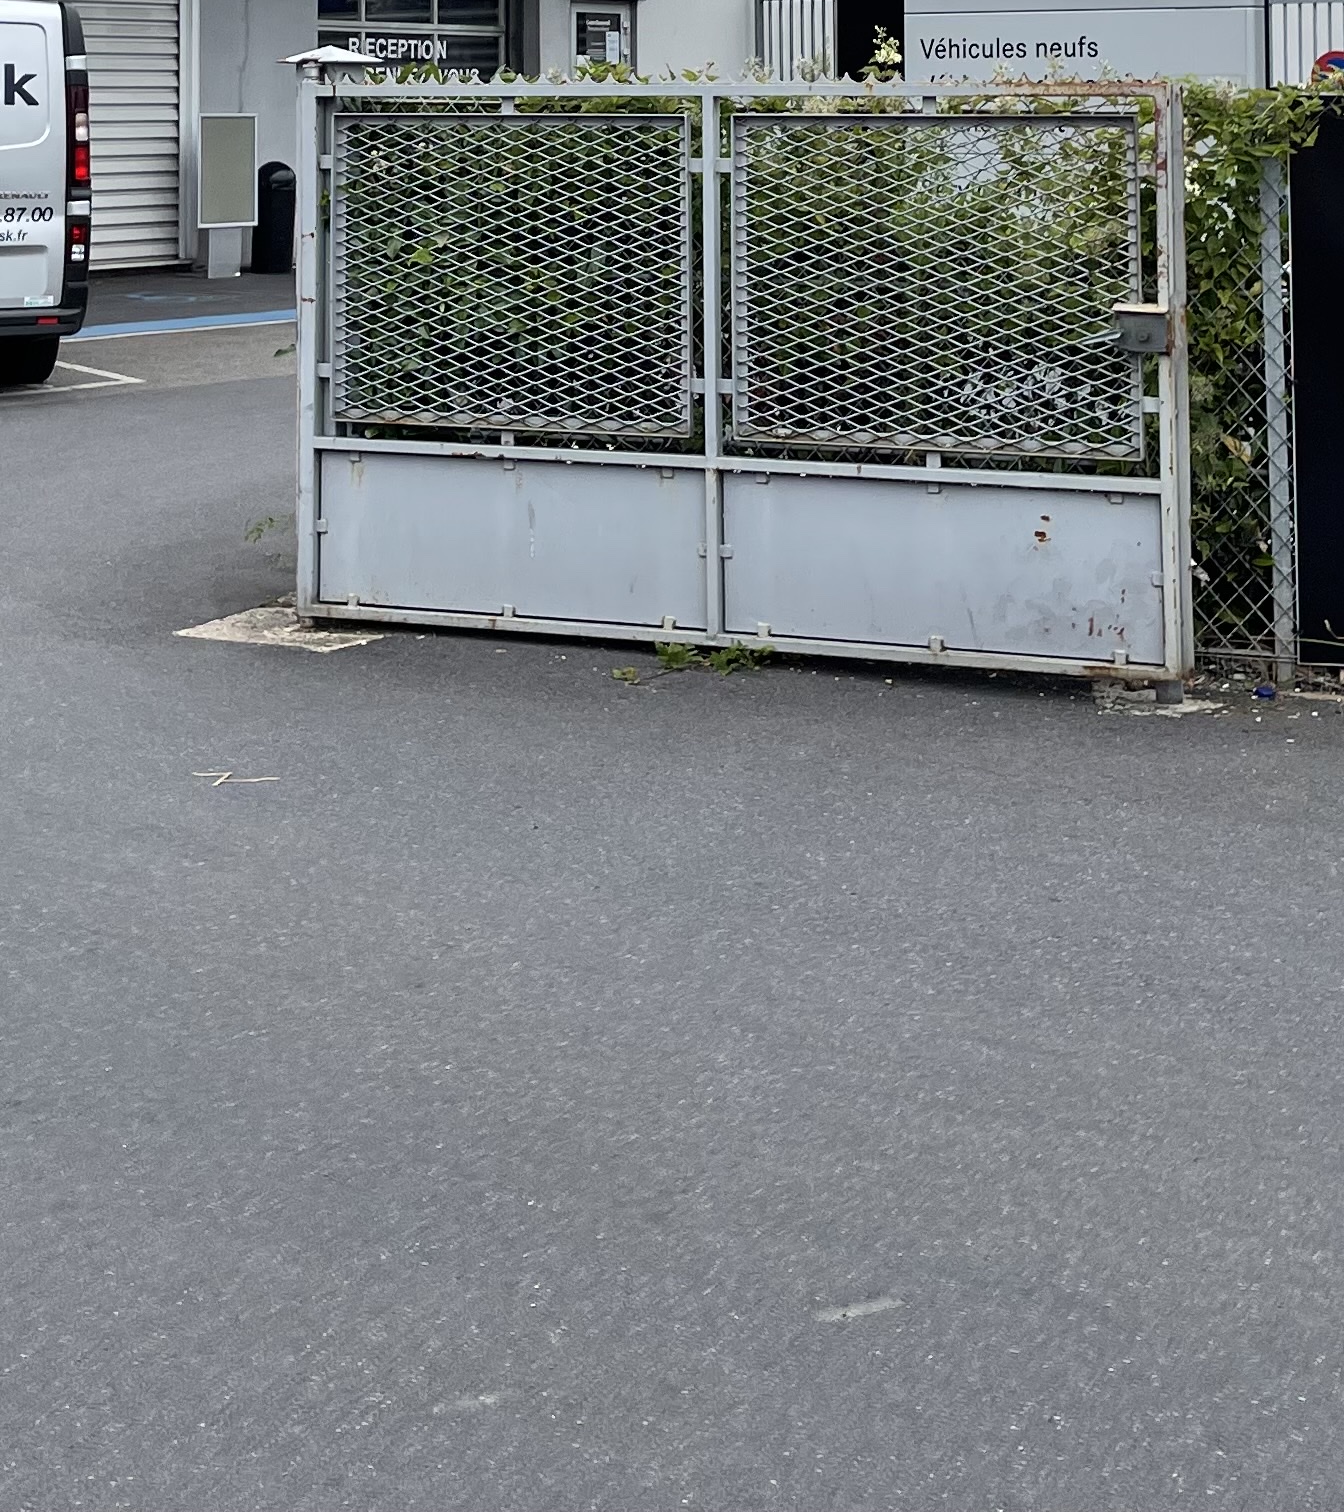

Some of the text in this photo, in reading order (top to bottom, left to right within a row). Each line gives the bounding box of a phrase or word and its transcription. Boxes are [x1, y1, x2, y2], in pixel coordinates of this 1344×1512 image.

[348, 37, 447, 59] RECEPTION
[920, 35, 1099, 60] Véhicules neufs
